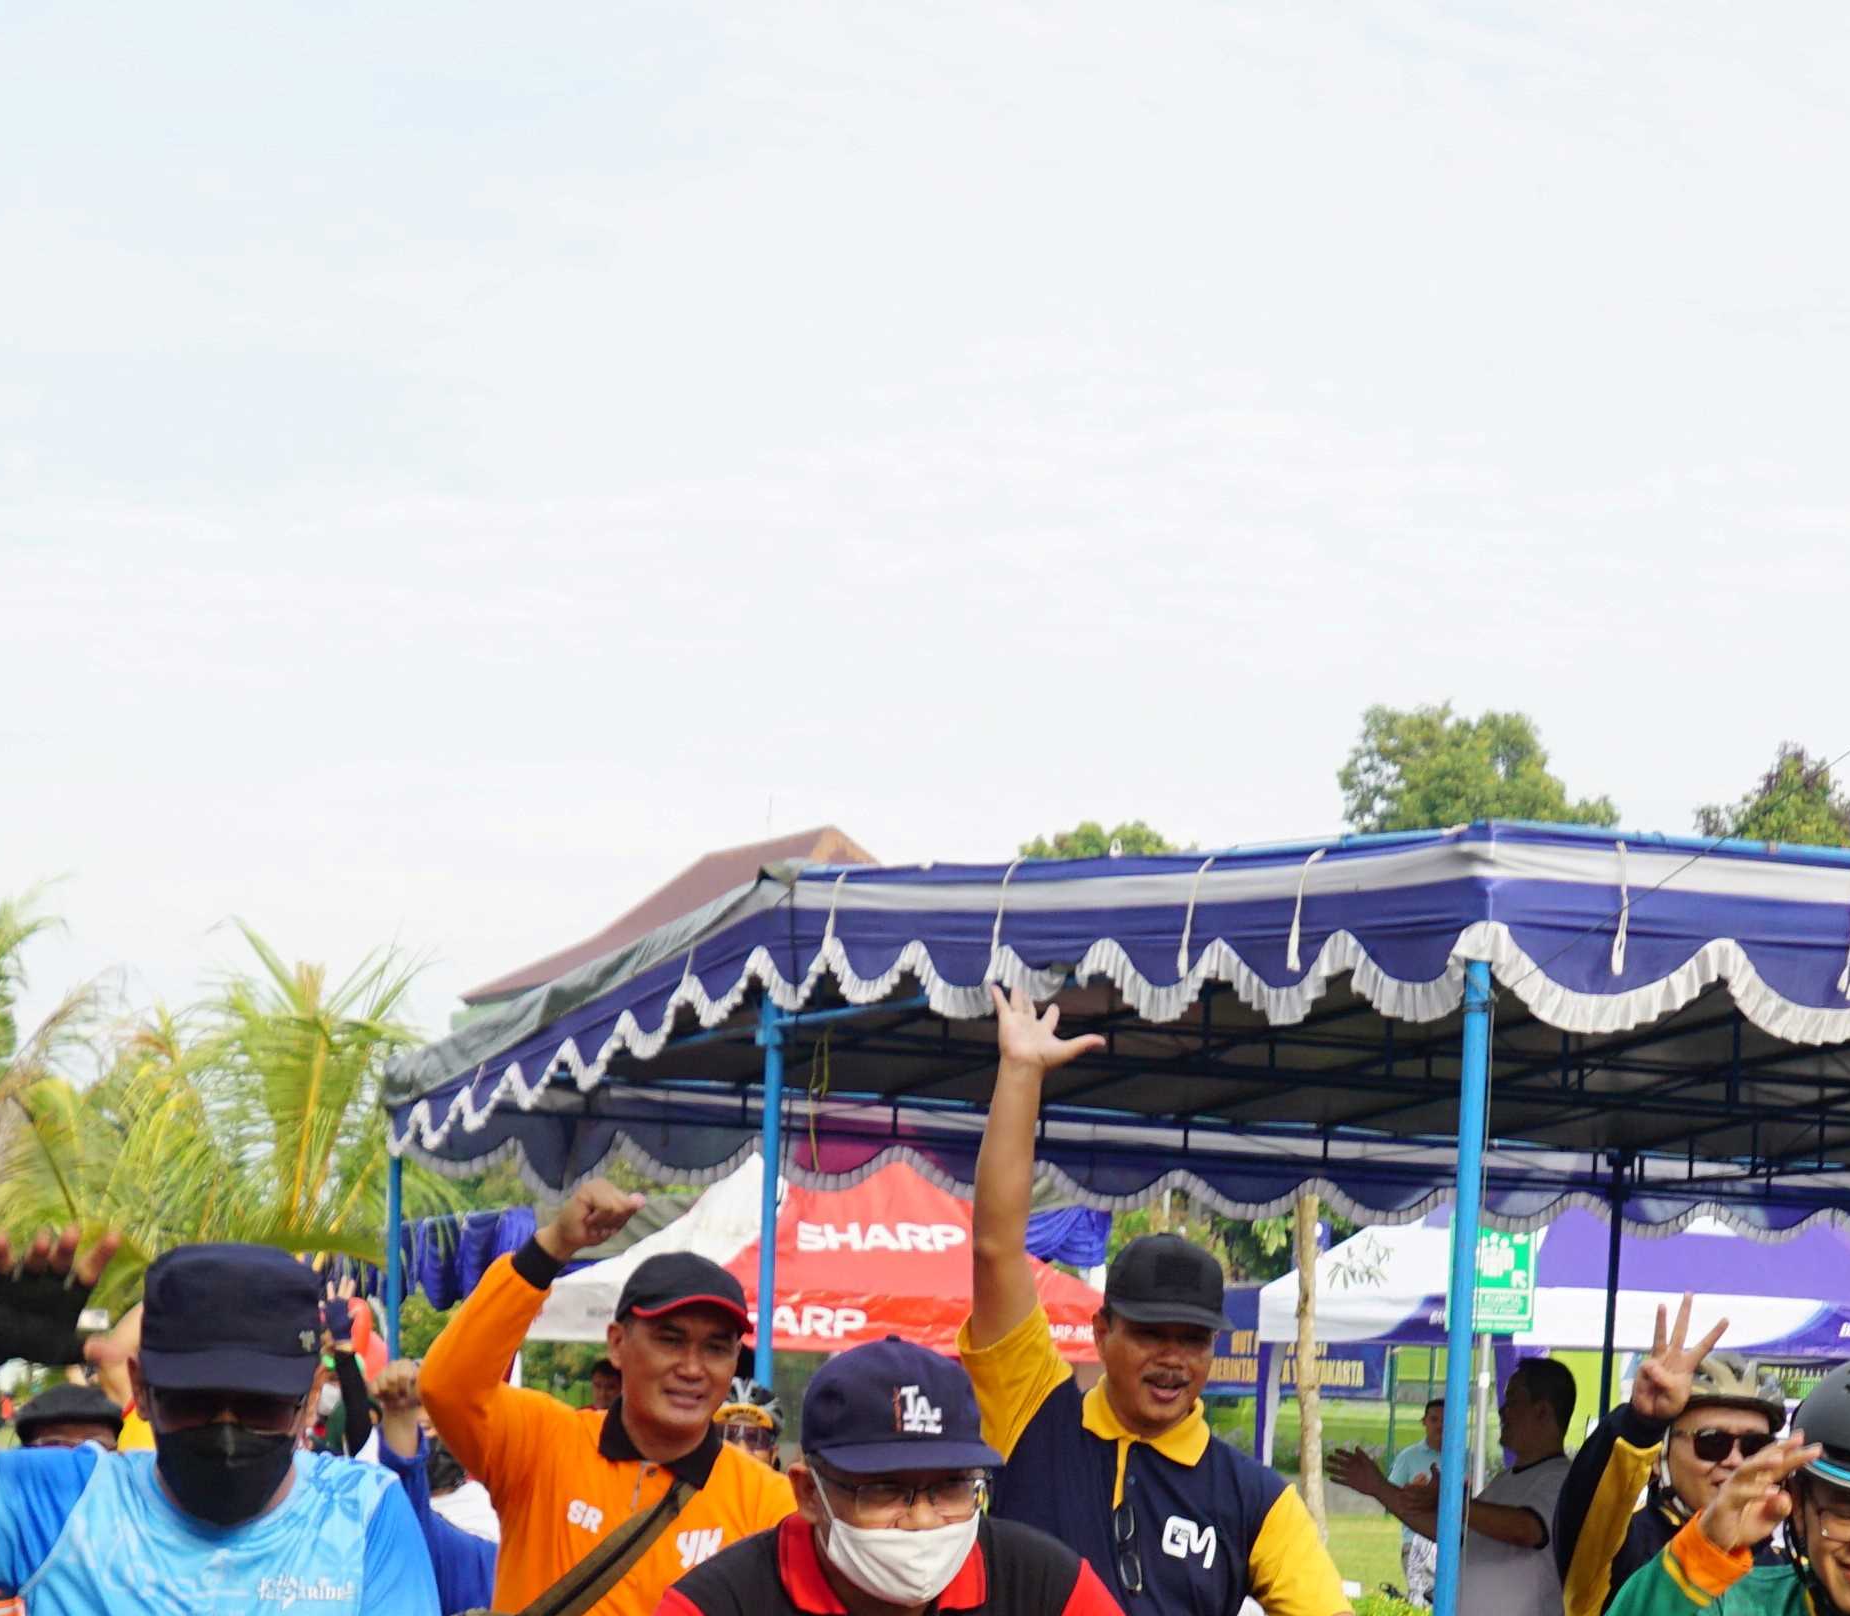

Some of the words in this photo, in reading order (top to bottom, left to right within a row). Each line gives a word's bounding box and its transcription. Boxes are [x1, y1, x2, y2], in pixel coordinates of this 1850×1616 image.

[797, 1222, 966, 1253] SHARP
[749, 1305, 867, 1337] ARP
[1231, 1330, 1254, 1354] HUT
[567, 1499, 603, 1535] SR
